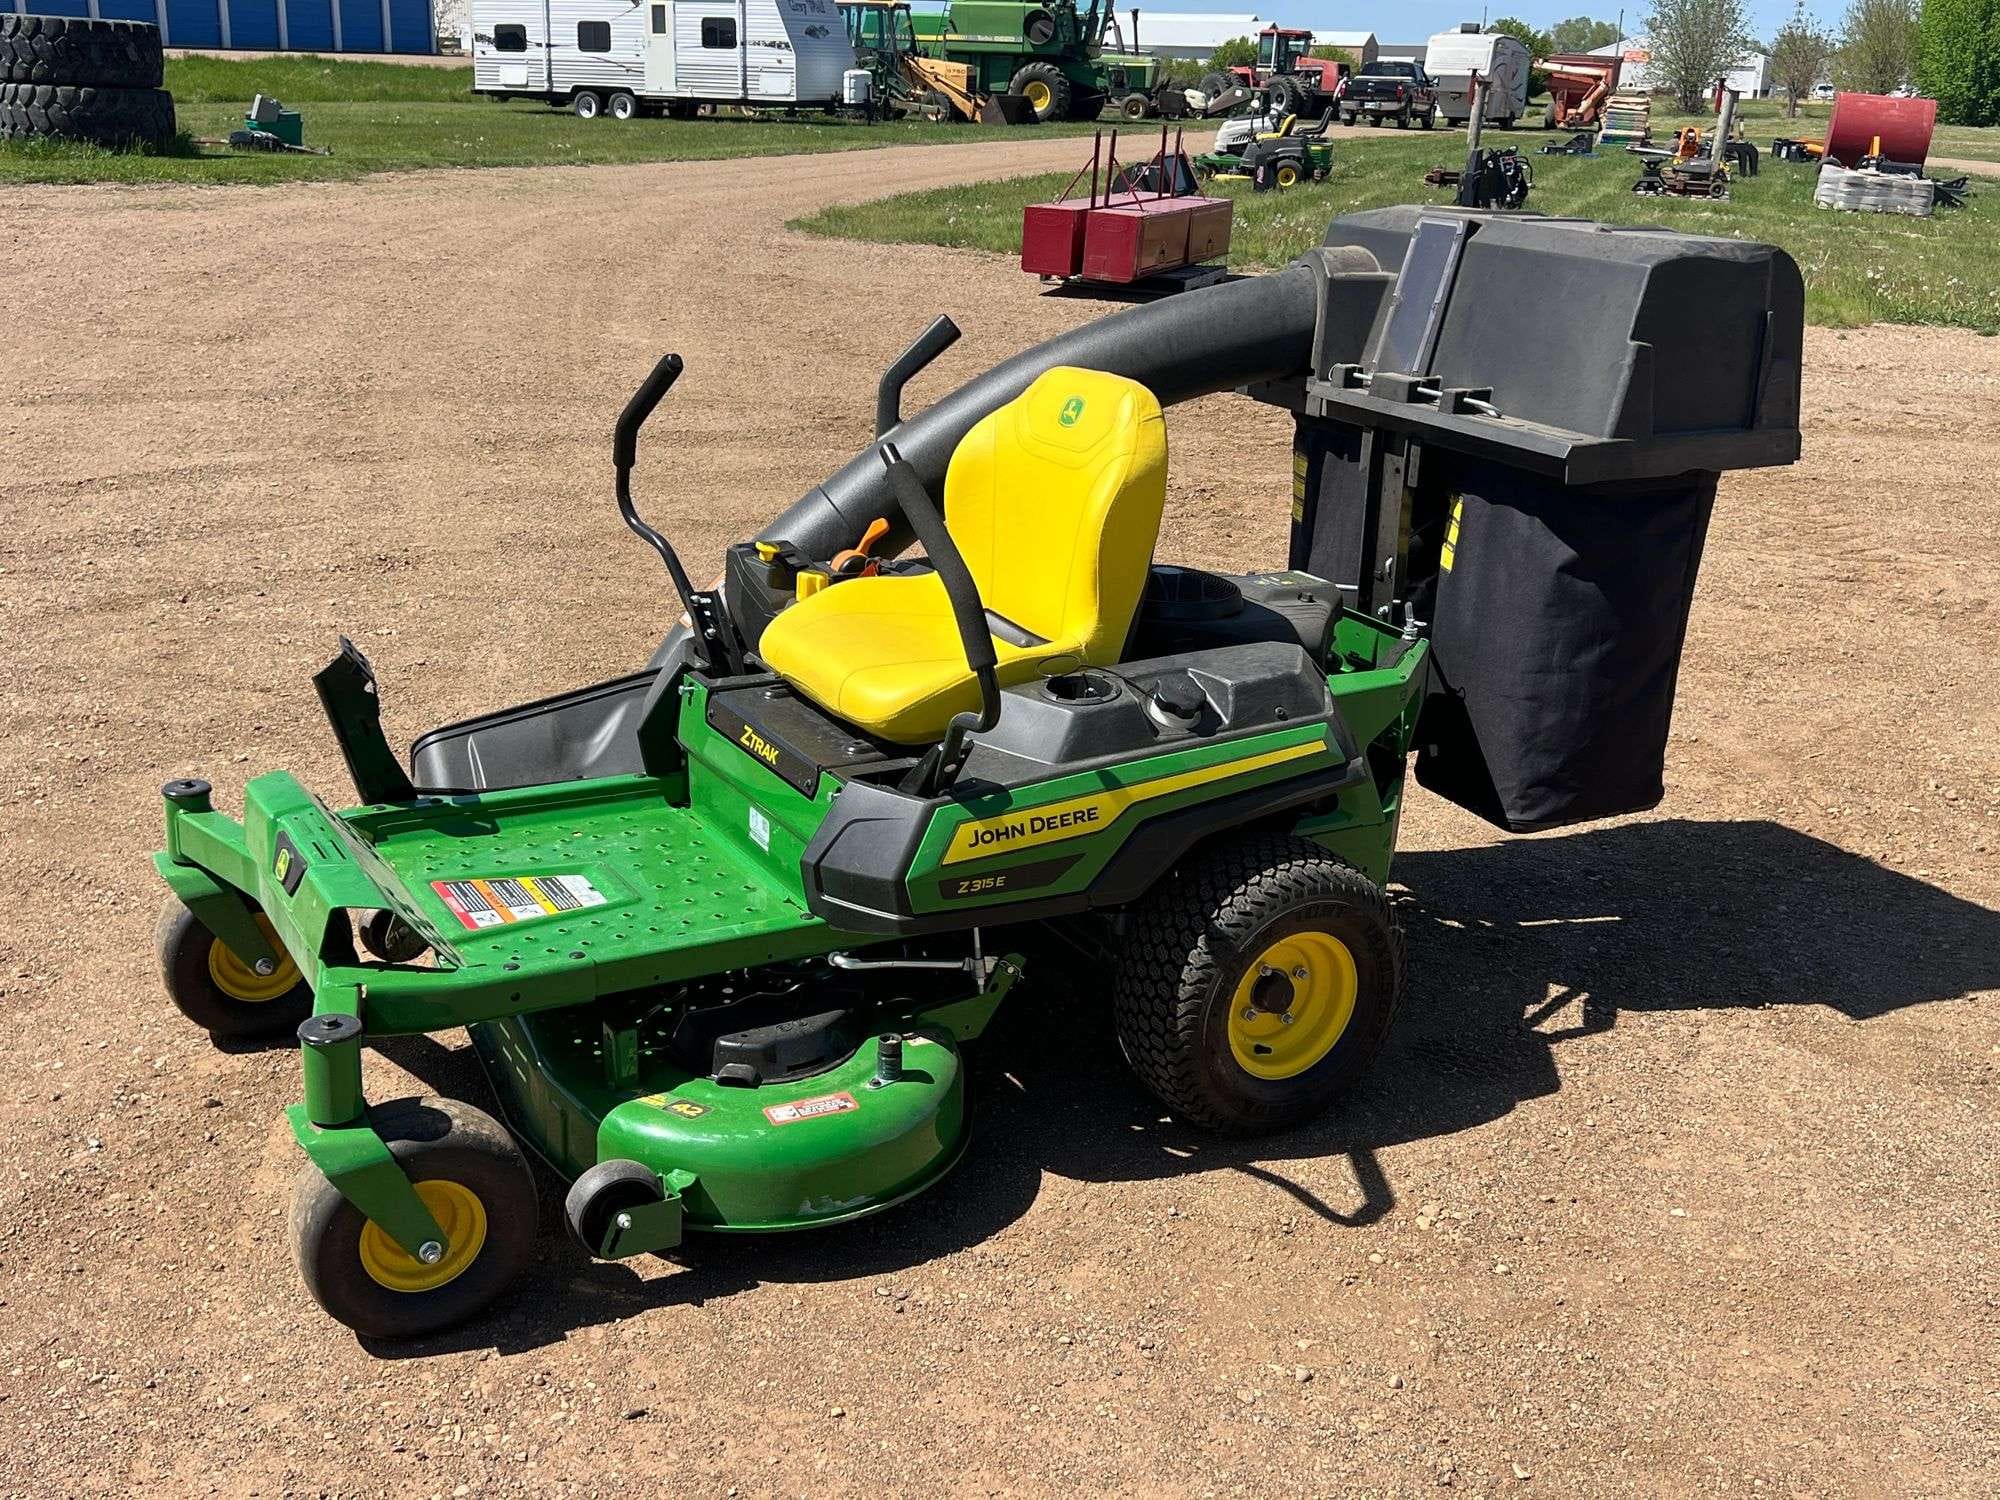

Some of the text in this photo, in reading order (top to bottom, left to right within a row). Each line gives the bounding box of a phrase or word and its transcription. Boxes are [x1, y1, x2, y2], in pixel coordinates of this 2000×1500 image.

[740, 724, 779, 765] ZTRAK
[968, 806, 1099, 848] JOHN DEERE
